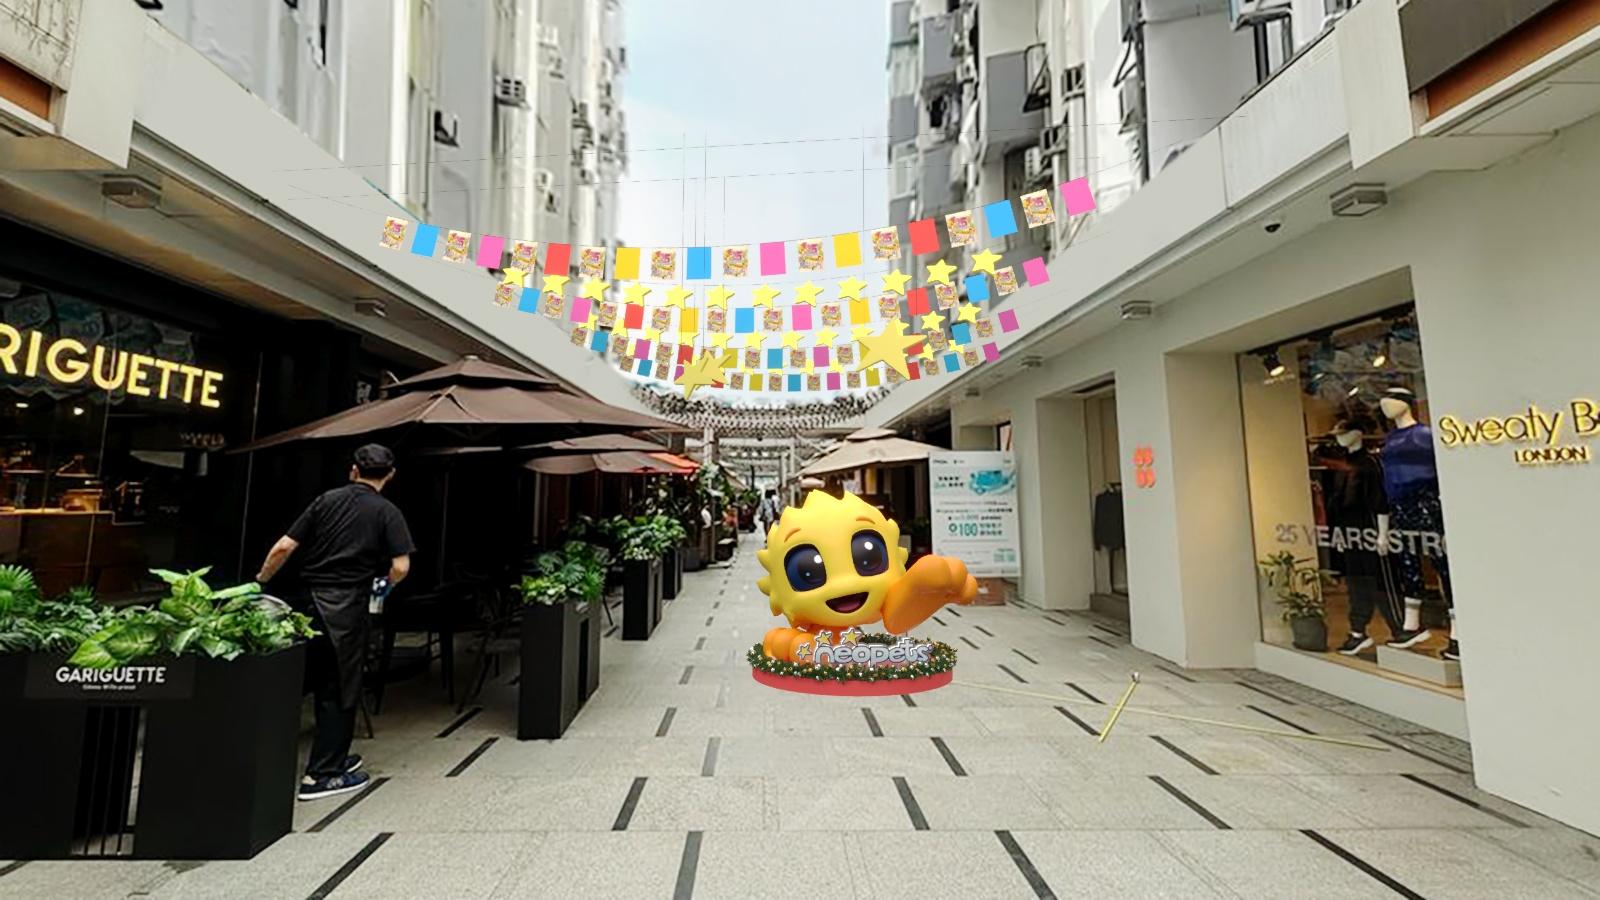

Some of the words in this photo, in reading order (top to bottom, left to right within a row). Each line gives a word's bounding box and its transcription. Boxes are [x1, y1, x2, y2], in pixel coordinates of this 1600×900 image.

[1439, 405, 1563, 446] Sweaty
[1570, 399, 1600, 436] B
[1515, 446, 1590, 464] LONDON
[1276, 523, 1298, 543] 25
[1302, 525, 1378, 552] YEARS
[814, 638, 929, 667] neopets
[55, 667, 166, 683] GARIGUETTE
